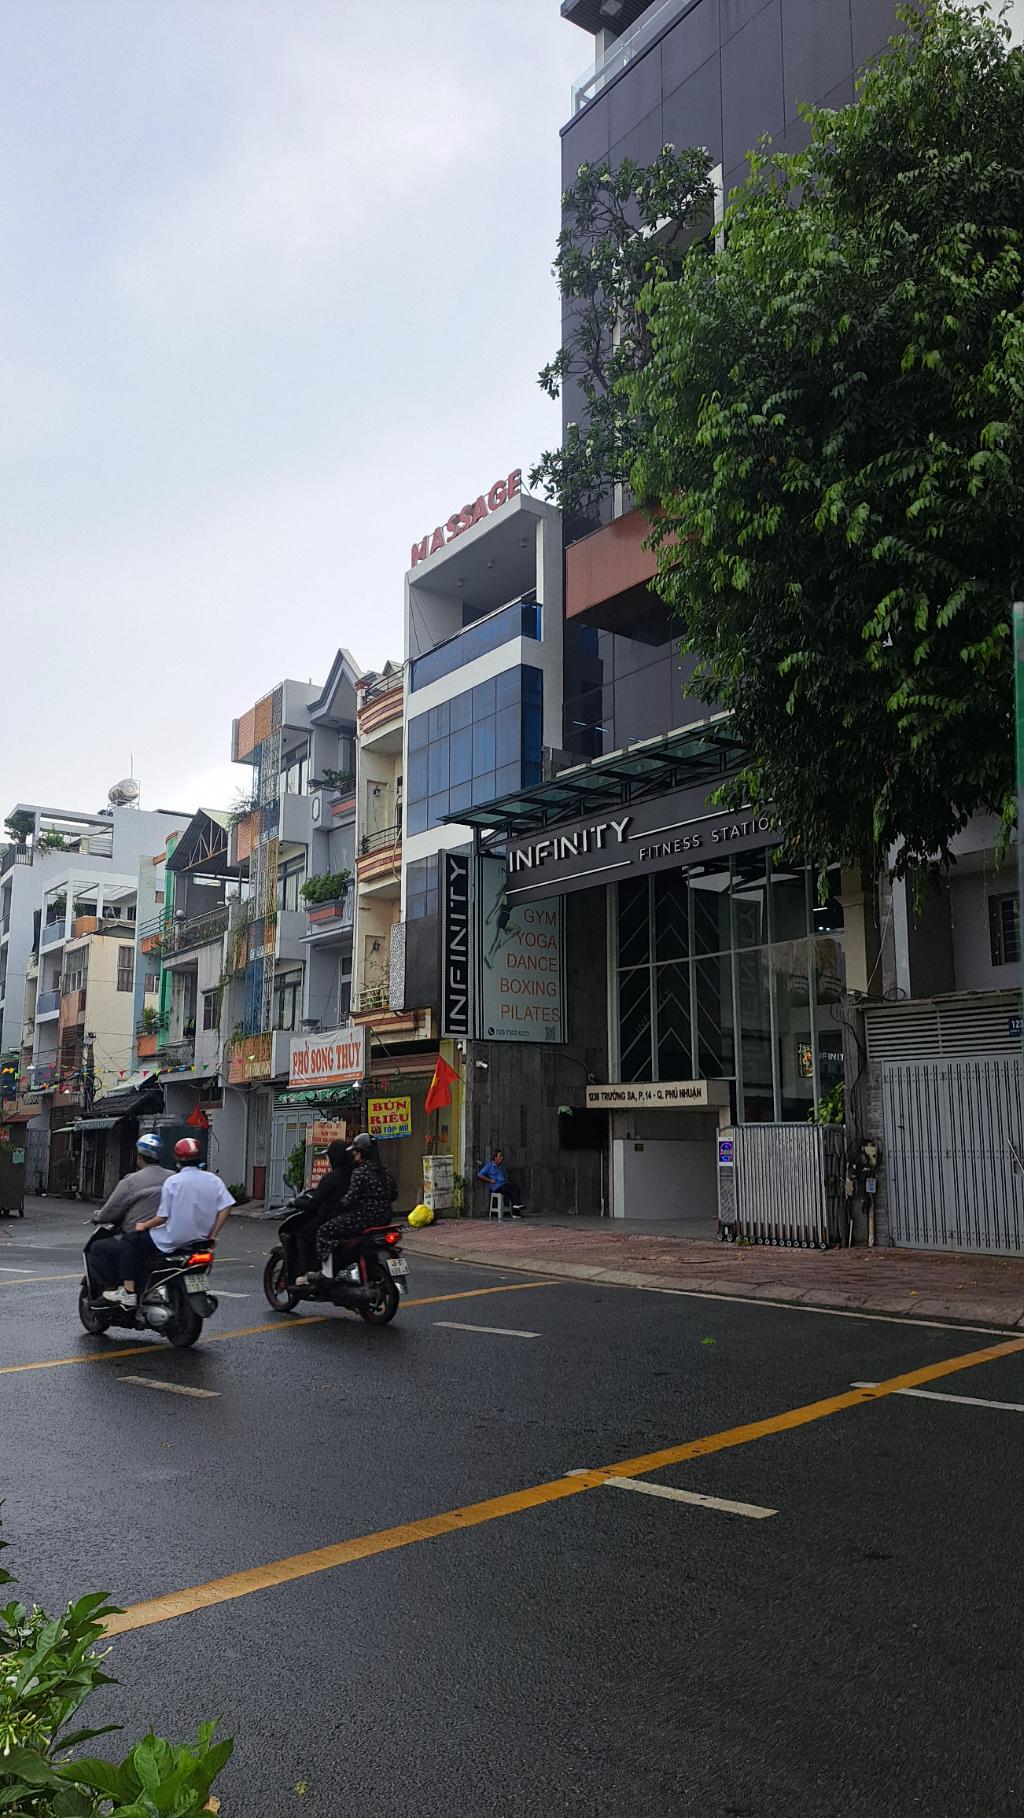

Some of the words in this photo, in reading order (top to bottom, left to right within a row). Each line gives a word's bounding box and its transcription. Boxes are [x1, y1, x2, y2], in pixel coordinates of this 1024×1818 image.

[411, 468, 522, 569] MASSAGE
[508, 816, 633, 874] INFINITY
[638, 834, 701, 862] FITNESS
[710, 816, 781, 844] STATIO
[523, 908, 556, 926] GYM
[449, 856, 467, 1032] INFINITY
[516, 932, 558, 950] YOGA
[507, 953, 558, 973] DANCE
[500, 977, 557, 997] BOXING
[500, 1004, 561, 1023] PILATES
[293, 1040, 310, 1075] PHỞ
[310, 1046, 334, 1073] SONG
[626, 1089, 638, 1103] SA,
[679, 1086, 702, 1101] NHUẬN
[372, 1100, 407, 1112] BÚN
[369, 1112, 409, 1125] RIÊU
